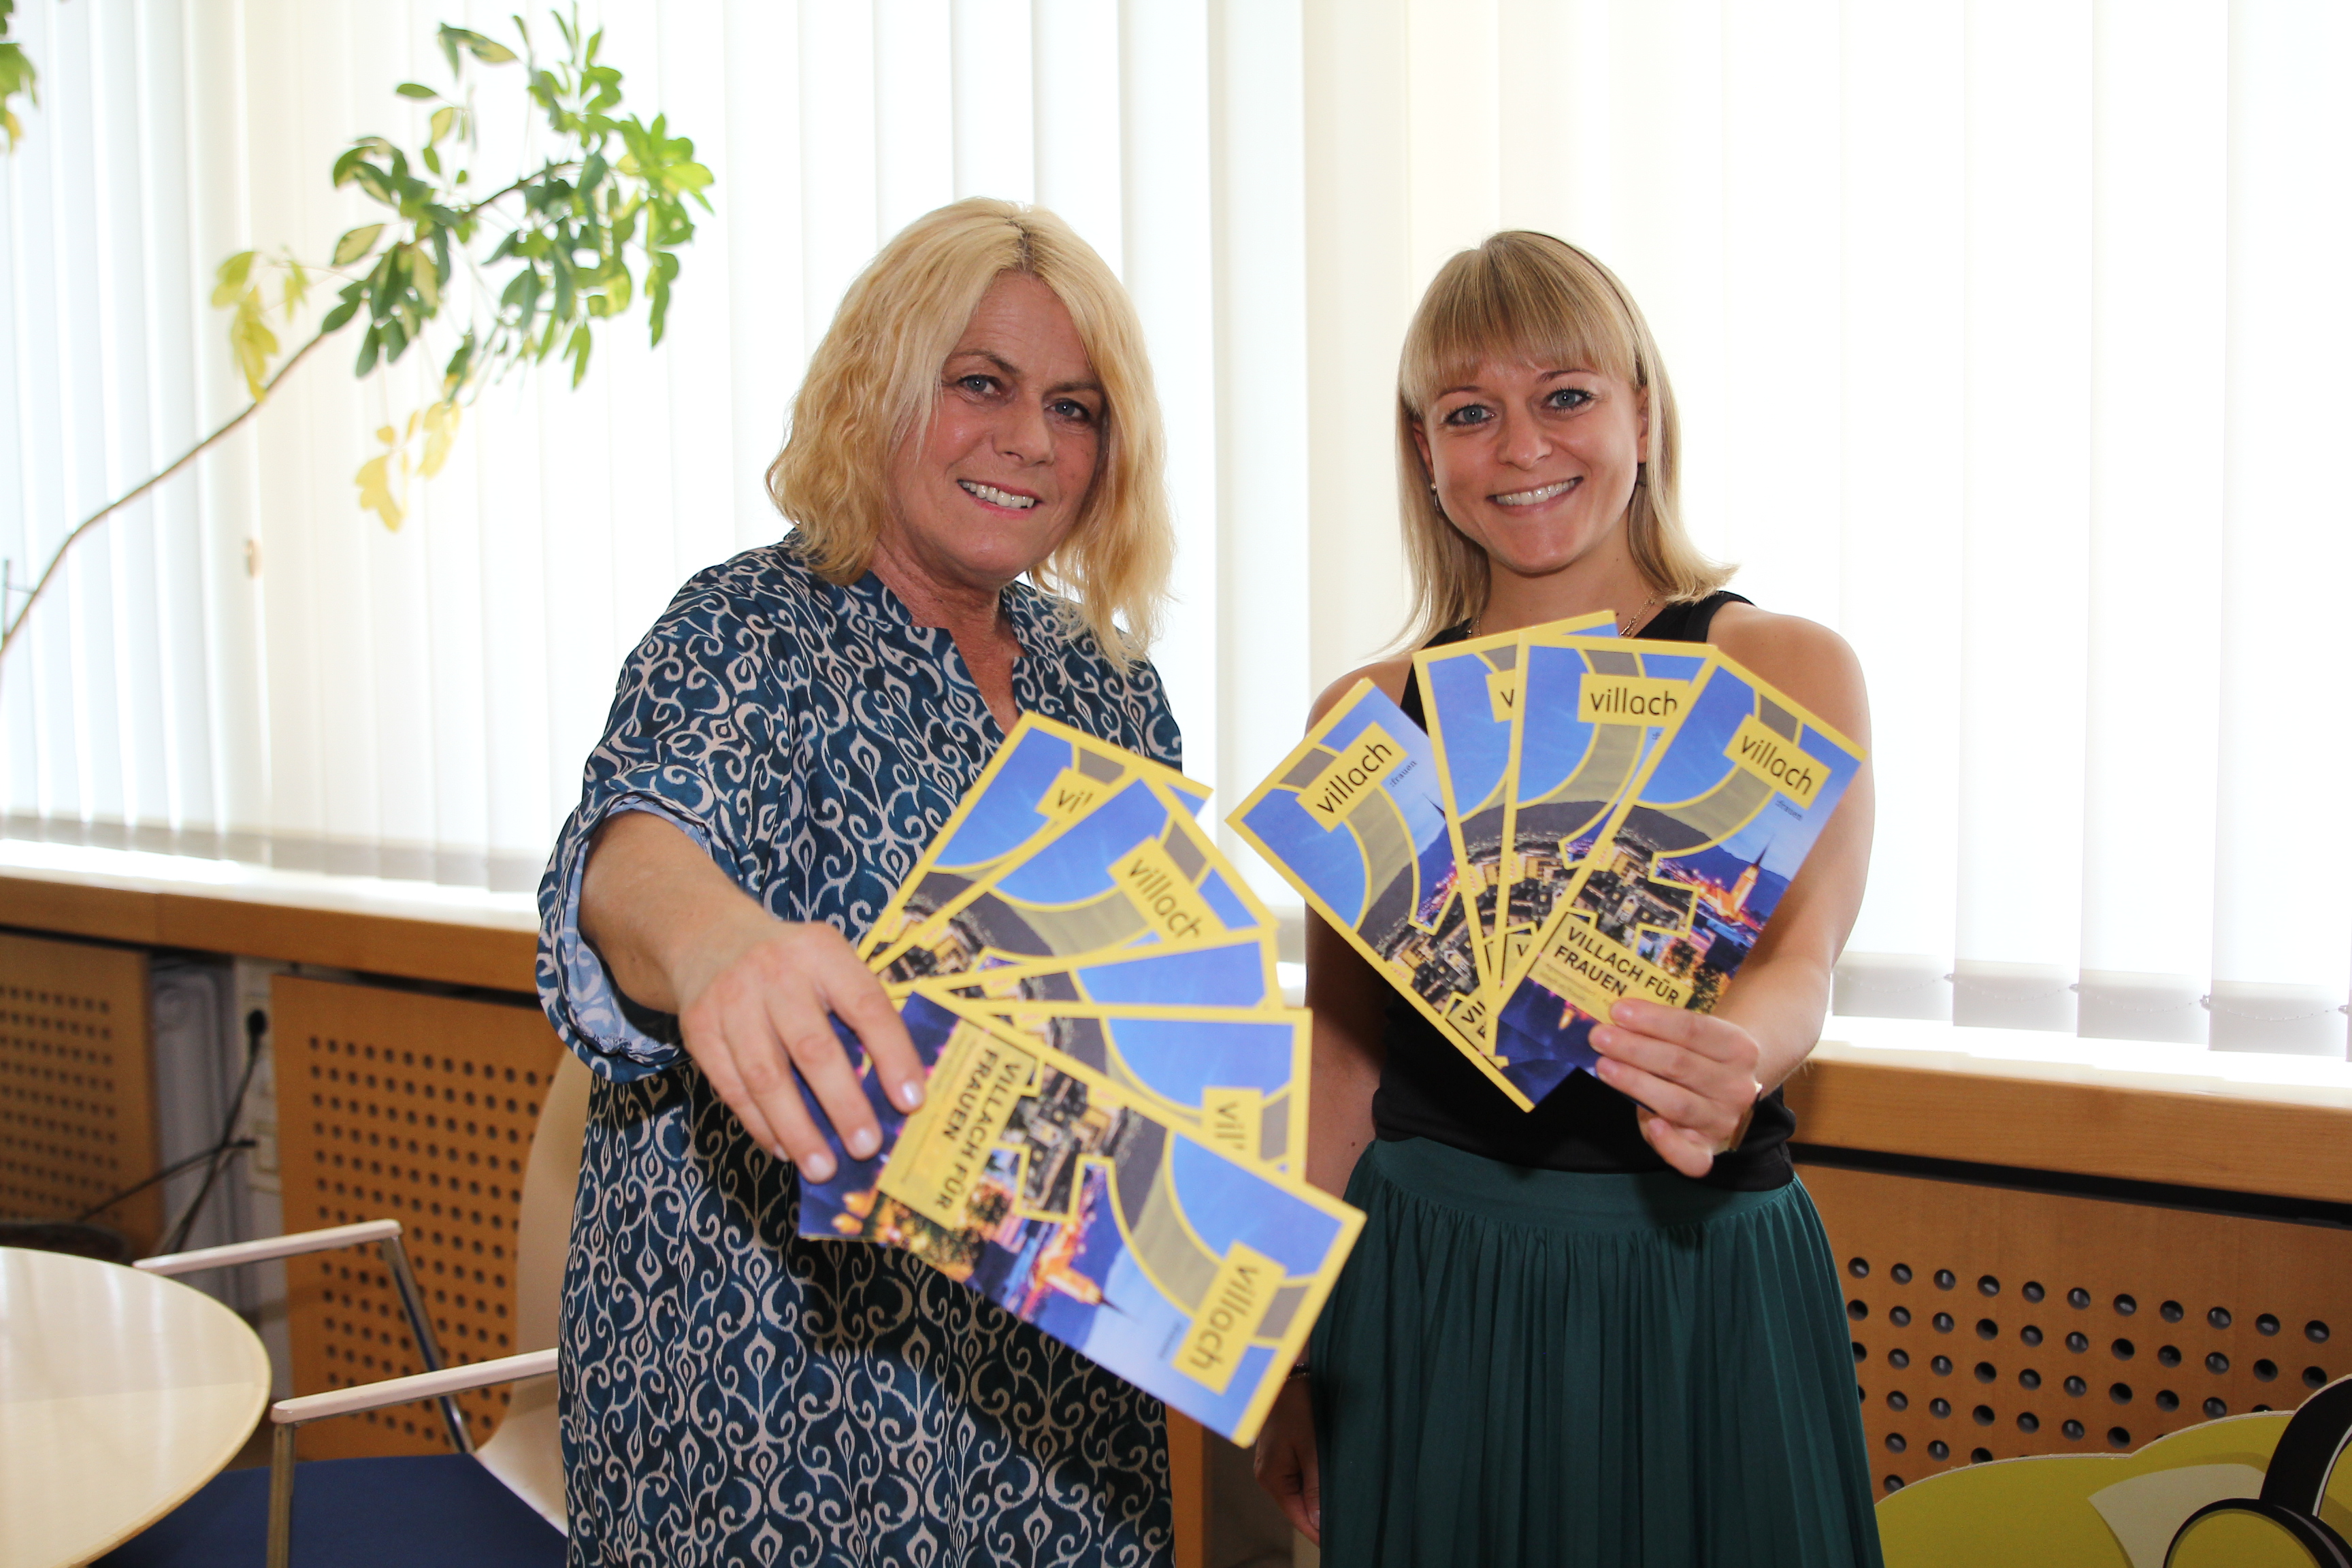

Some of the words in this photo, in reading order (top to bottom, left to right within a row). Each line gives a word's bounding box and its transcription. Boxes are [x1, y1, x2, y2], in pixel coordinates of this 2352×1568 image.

[1590, 687, 1678, 717] villach
[1316, 744, 1392, 813] villach
[1741, 735, 1812, 796] villach
[1129, 858, 1202, 938] villach
[1554, 945, 1628, 997] FRAUEN
[1568, 926, 1644, 981] VILLACH
[1644, 975, 1679, 1005] FÜR
[943, 1049, 999, 1141] FRAUEN
[962, 1063, 1021, 1160] VILLACH
[935, 1162, 968, 1210] FÜR
[1189, 1266, 1260, 1369] villach
